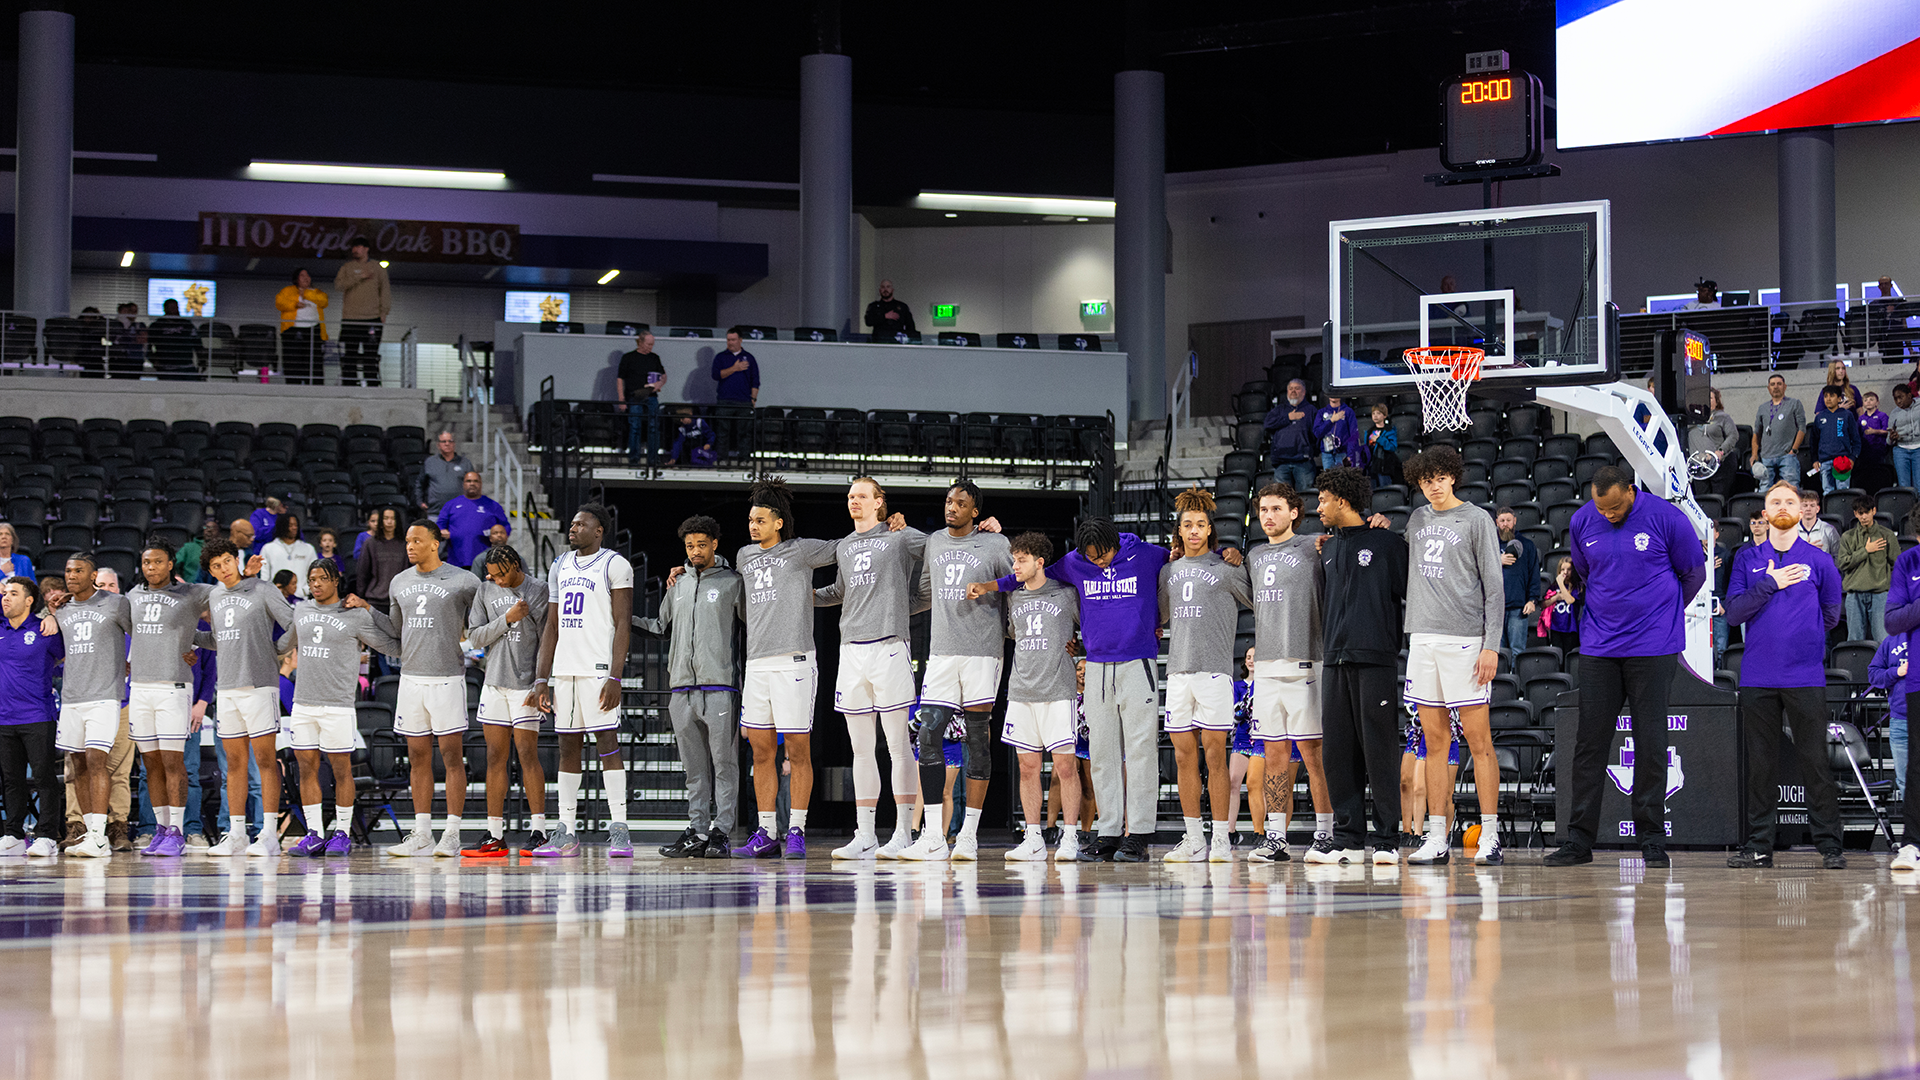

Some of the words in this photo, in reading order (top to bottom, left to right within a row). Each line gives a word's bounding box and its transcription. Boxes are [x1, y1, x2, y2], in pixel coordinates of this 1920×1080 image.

[1461, 78, 1511, 104] 20:00
[280, 220, 365, 258] Tripl
[376, 222, 432, 253] Oak
[441, 228, 513, 261] BBQ
[1632, 426, 1654, 456] LEGACY
[1415, 525, 1462, 546] TARLETON
[844, 539, 889, 558] TARLETON
[1423, 538, 1444, 563] 22
[743, 555, 787, 574] TARLETON
[853, 551, 872, 572] 25
[933, 550, 981, 569] TARLETON
[1253, 551, 1300, 568] TARLETON
[754, 567, 773, 590] 24
[849, 572, 876, 587] STATE
[944, 564, 966, 586] 97
[1167, 568, 1220, 586] TARLETON
[1263, 564, 1277, 587] 6
[400, 583, 450, 599] TARLETON
[560, 577, 596, 592] TARLETON
[1116, 576, 1137, 595] STATE
[1182, 581, 1194, 602] 0
[134, 594, 179, 608] TARLETON
[491, 596, 521, 608] TARLE
[751, 589, 777, 604] STATE
[938, 588, 966, 600] STATE
[1256, 589, 1283, 602] STATE
[213, 596, 252, 613] TARLETON
[415, 595, 427, 615] 2
[563, 592, 585, 615] 20
[1012, 600, 1062, 619] TARLETON
[62, 610, 106, 627] TARLETON
[143, 604, 162, 622] 10
[224, 608, 235, 628] 8
[1174, 606, 1202, 619] STATE
[73, 621, 92, 641] 30
[136, 624, 163, 634] STATE
[298, 614, 347, 631] TARLETON
[408, 617, 434, 628] STATE
[561, 618, 583, 628] STATE
[1025, 614, 1043, 636] 14
[217, 629, 240, 642] STATE
[312, 625, 324, 644] 3
[69, 642, 94, 654] STATE
[302, 645, 330, 659] STATE
[1020, 638, 1048, 651] STATE
[1616, 715, 1688, 731] ARON
[1780, 813, 1810, 825] MANAGEME
[1619, 821, 1672, 837] STE
